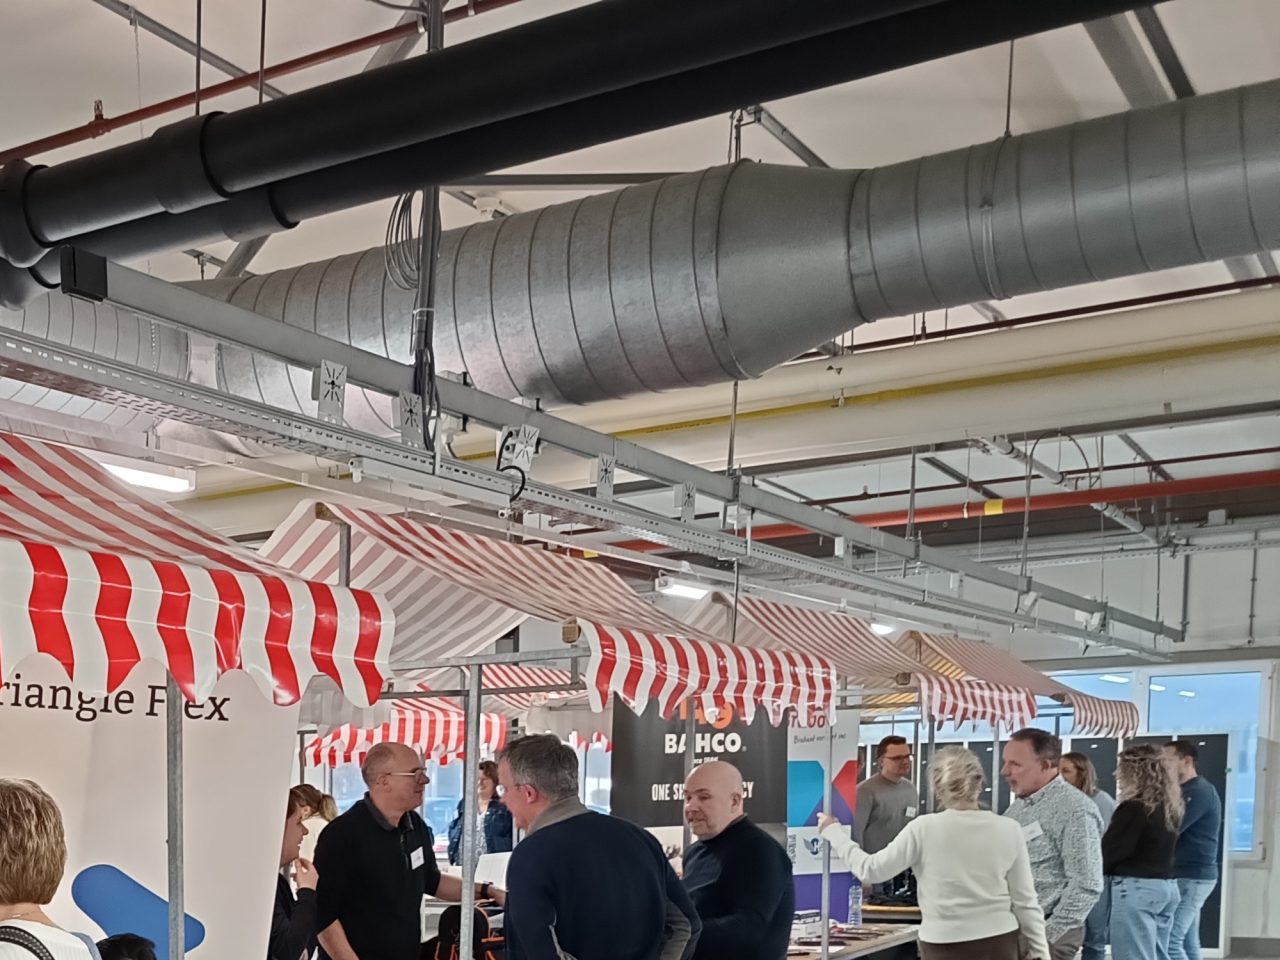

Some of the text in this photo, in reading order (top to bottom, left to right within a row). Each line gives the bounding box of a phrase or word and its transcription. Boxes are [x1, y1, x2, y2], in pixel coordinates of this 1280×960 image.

[145, 684, 231, 721] Fex
[664, 732, 741, 754] BAHCO
[651, 784, 671, 801] ONE
